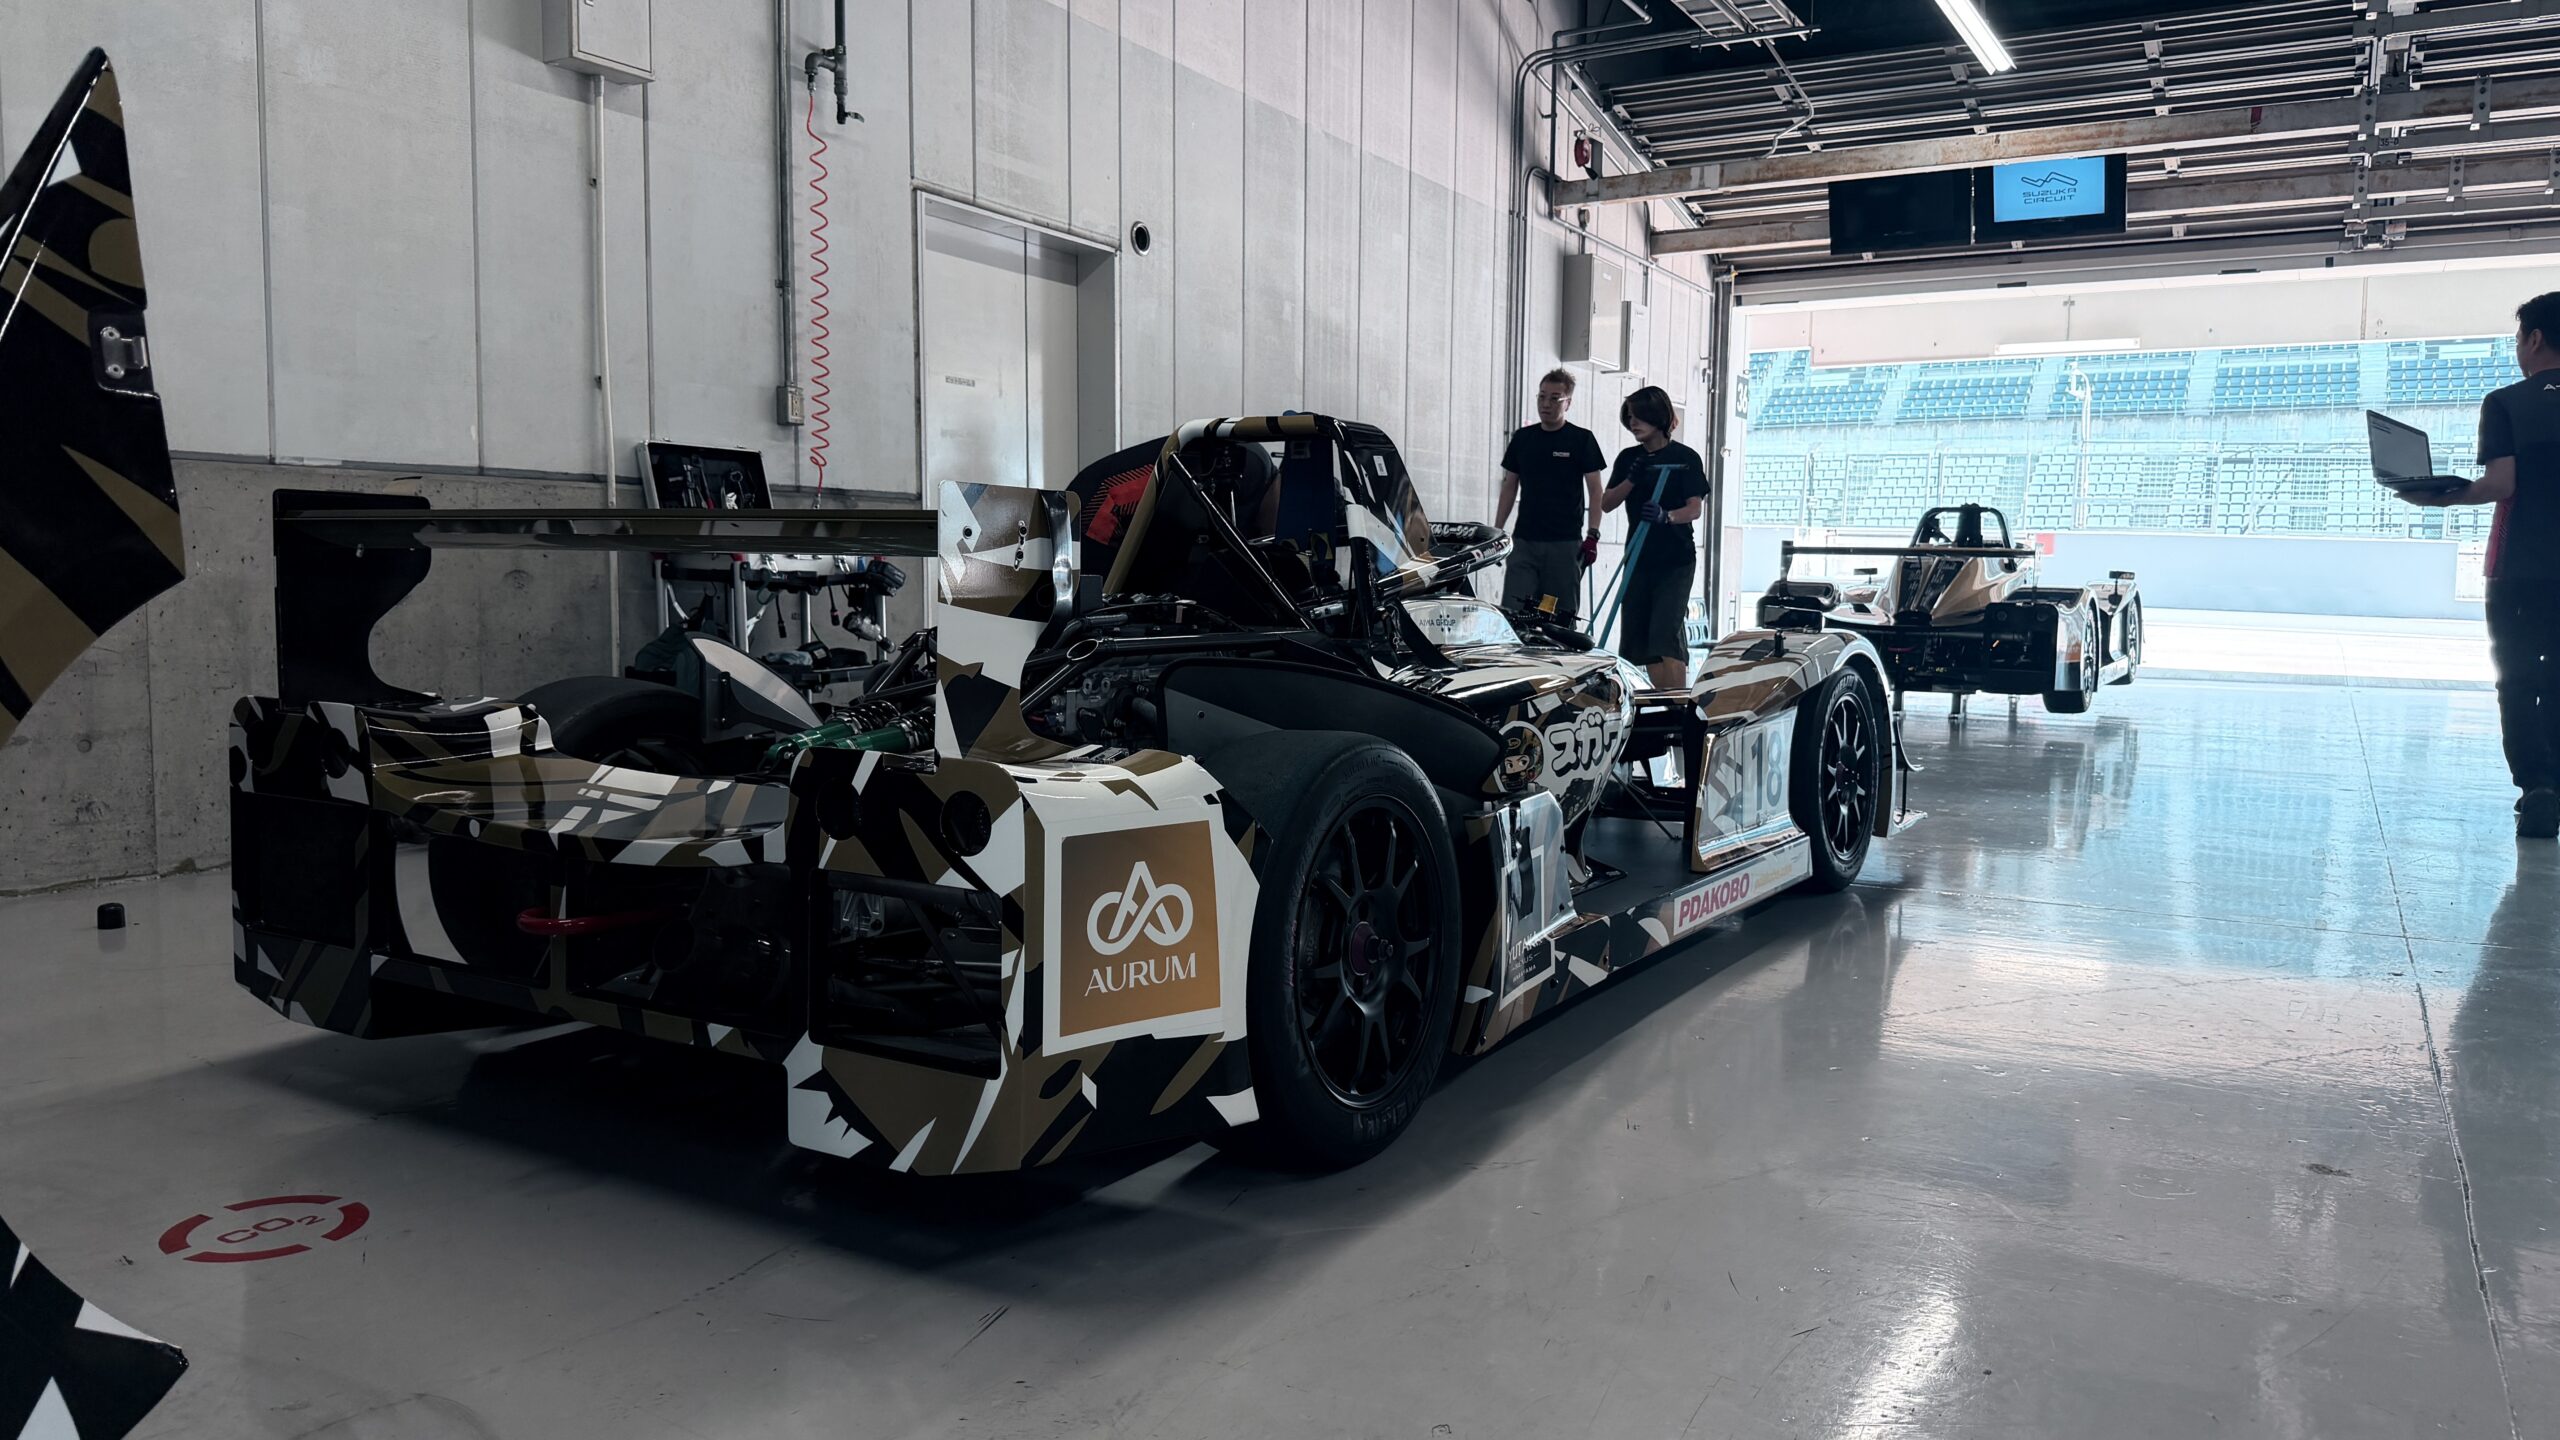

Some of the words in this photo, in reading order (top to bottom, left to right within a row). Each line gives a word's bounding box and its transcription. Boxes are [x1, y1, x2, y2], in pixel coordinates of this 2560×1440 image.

[2022, 187, 2077, 198] SUZUKA
[2023, 194, 2076, 205] CIRCUIT
[1736, 382, 1748, 414] 36
[1750, 730, 1783, 811] 18
[1678, 872, 1751, 928] PDAKOBO
[1084, 952, 1197, 997] AURUM
[217, 1215, 326, 1244] CO2
